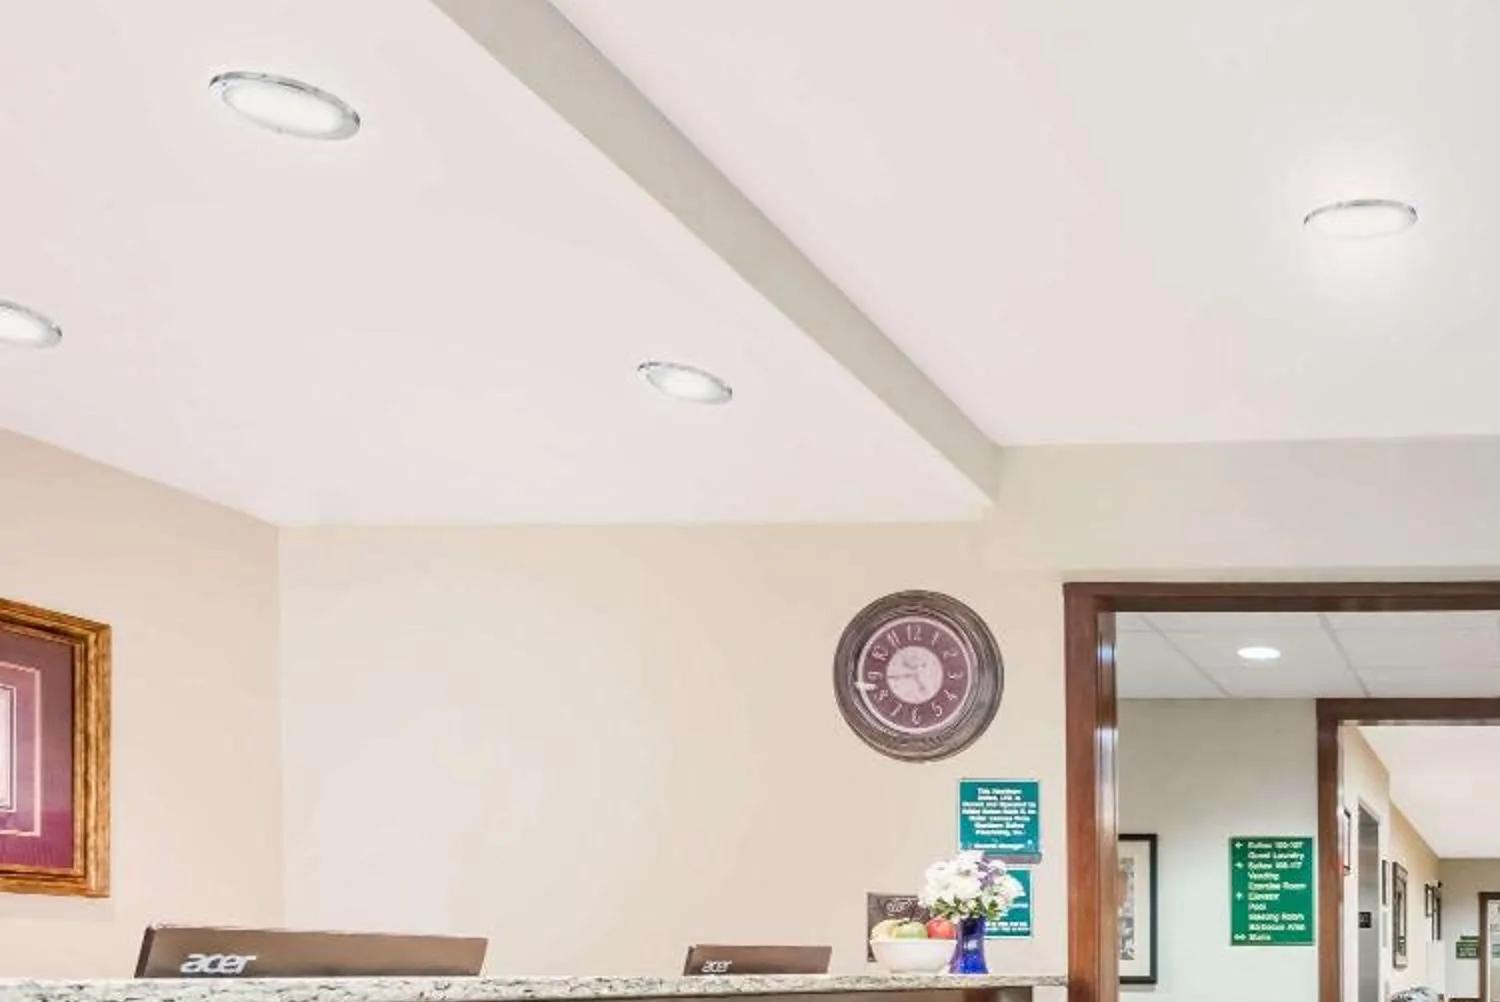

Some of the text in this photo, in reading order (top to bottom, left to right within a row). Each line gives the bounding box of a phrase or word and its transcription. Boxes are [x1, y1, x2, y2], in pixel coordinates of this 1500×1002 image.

[907, 624, 921, 640] 12
[1273, 852, 1304, 861] Laundry
[1248, 872, 1279, 881] Vending
[1248, 903, 1266, 911] Pool
[181, 953, 257, 974] acer
[702, 960, 733, 973] acer
